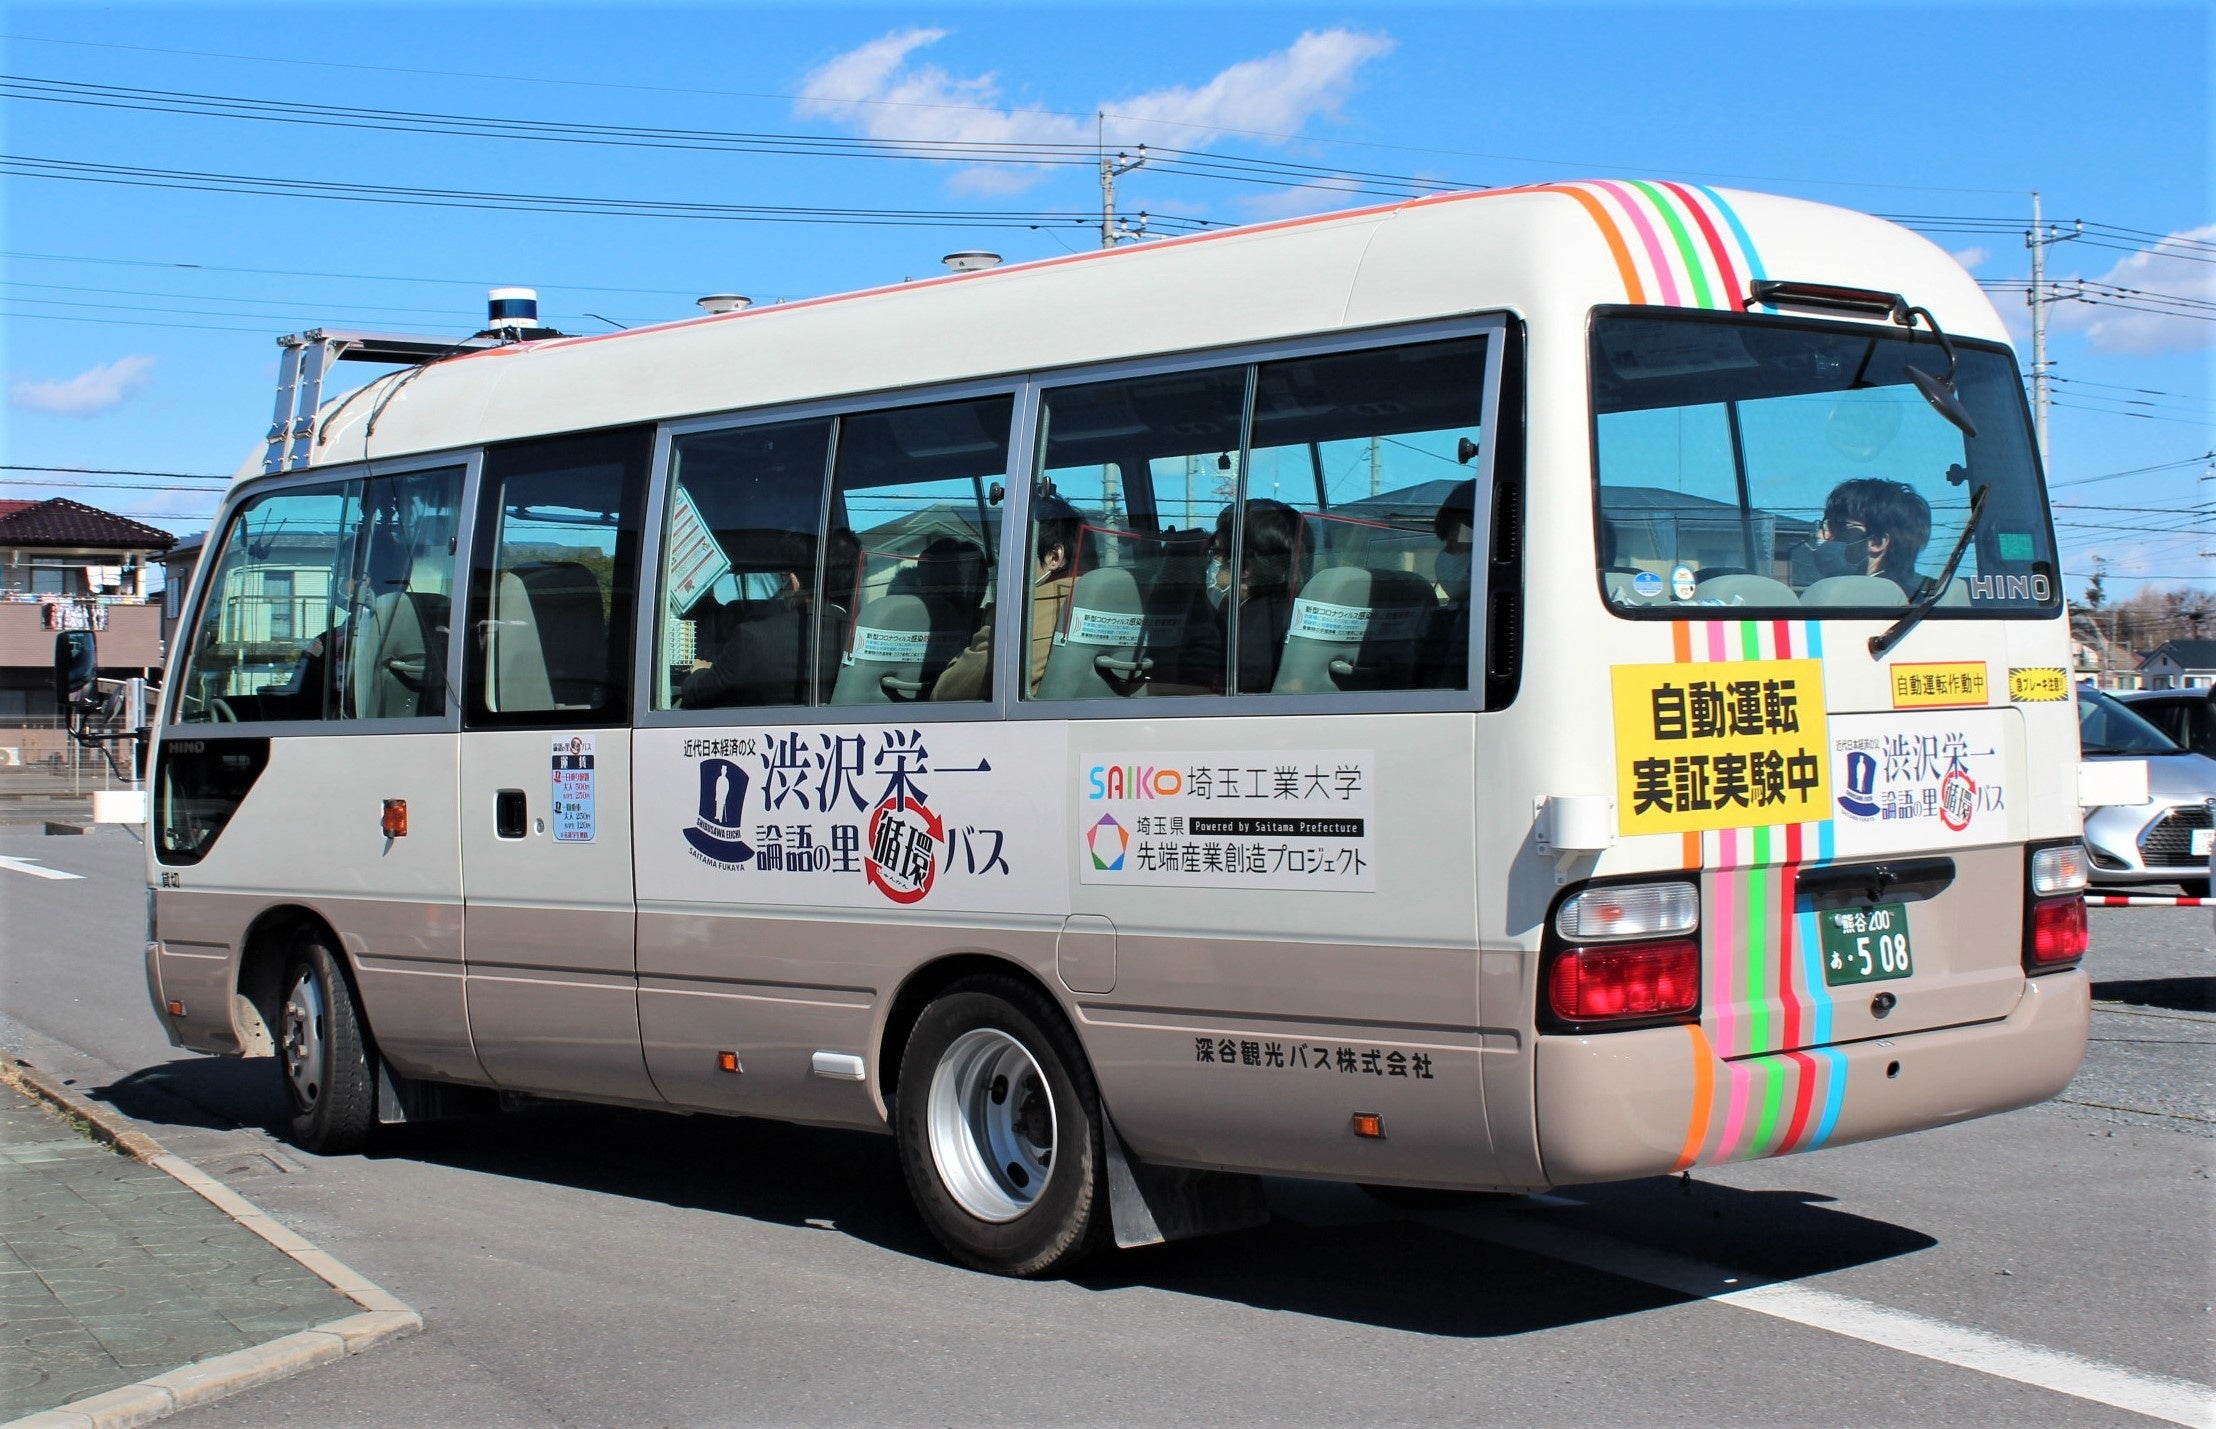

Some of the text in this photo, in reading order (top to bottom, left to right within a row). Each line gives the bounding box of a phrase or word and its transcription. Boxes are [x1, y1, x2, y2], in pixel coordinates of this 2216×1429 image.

[1970, 574, 2051, 602] HINO
[1896, 672, 1985, 697] 自動運転作動中
[1651, 679, 1800, 741] 自動運転
[168, 741, 205, 754] HINO
[683, 738, 757, 758] 近代日本経済の父
[1882, 731, 1996, 783] 渋沢栄一
[760, 729, 993, 813] 渋沢栄一
[1088, 764, 1362, 800] SAIKO 埼玉工業大学
[1632, 748, 1820, 817] 実証実験中
[1881, 788, 1938, 820] 論語の里
[1976, 784, 2005, 812] バス
[1136, 816, 1359, 836] 埼玉県 Powered by Saitama Prefecture
[688, 847, 746, 872] SAITAMA FUKAYA
[756, 810, 1010, 891] 論語の里 循環 バス
[1136, 842, 1367, 876] 先端産業創造プロジェクト
[1830, 950, 1843, 970] あ
[1194, 1036, 1435, 1080] 深谷観光バス株式会社
